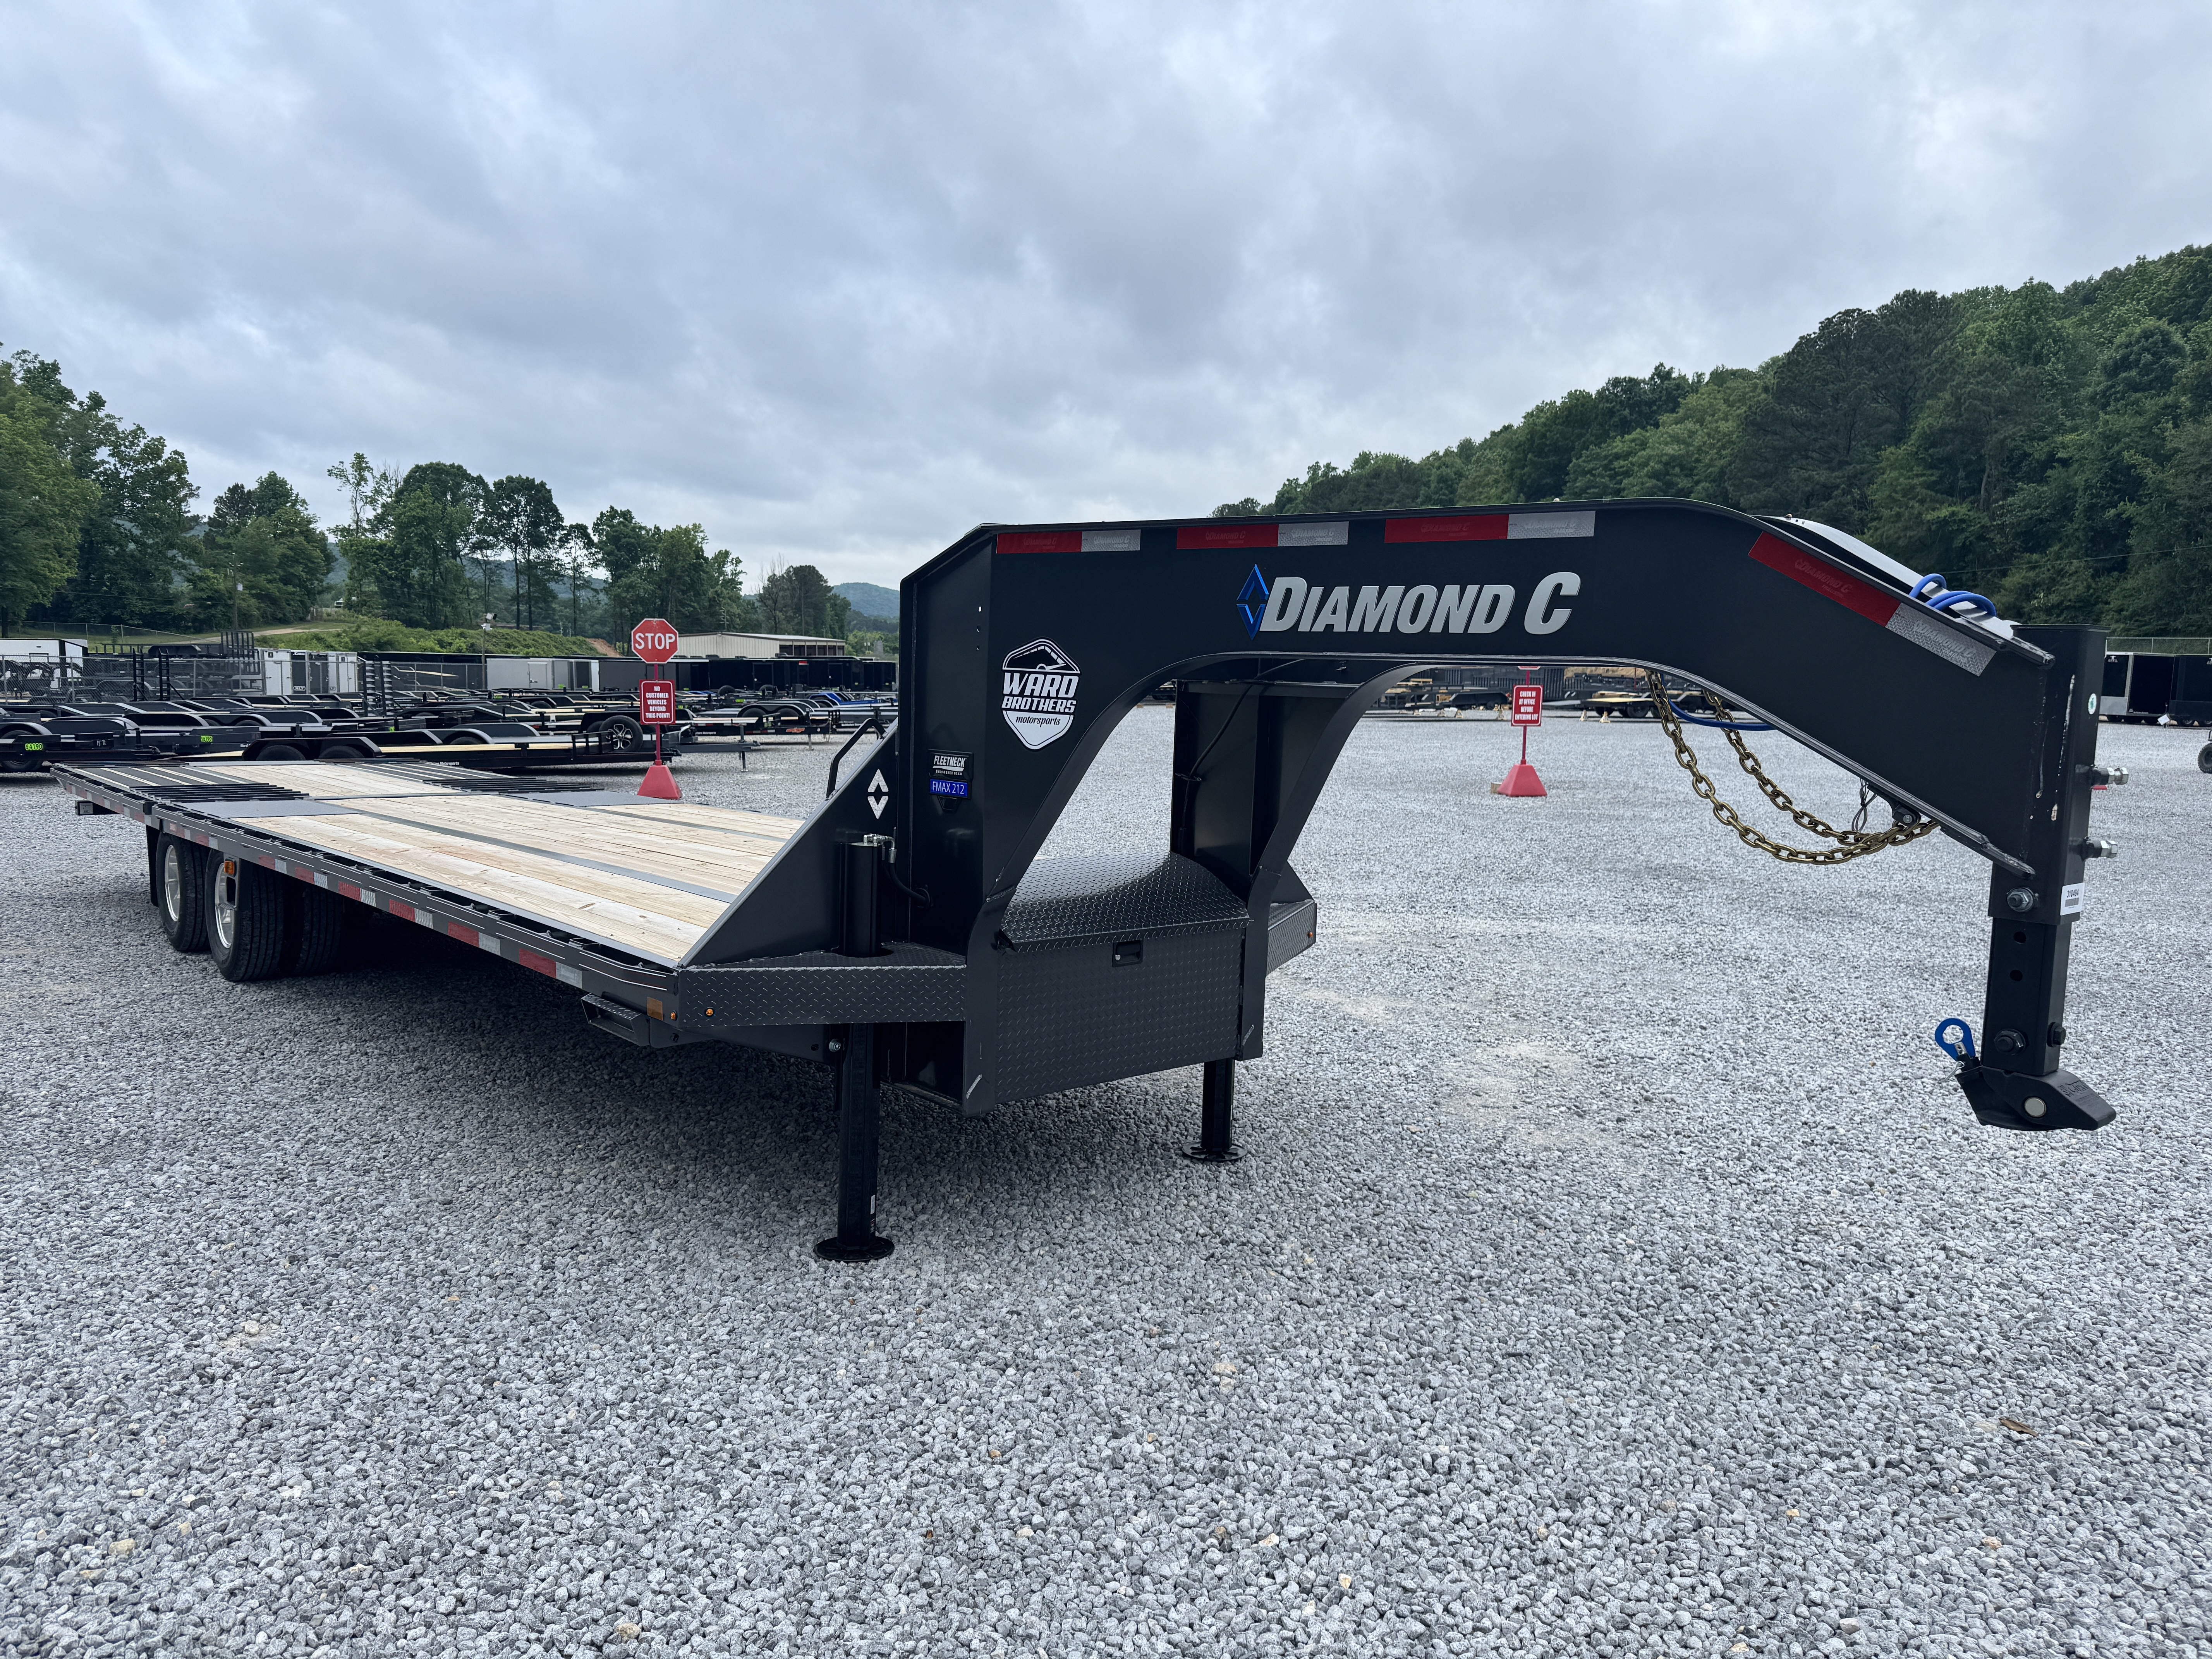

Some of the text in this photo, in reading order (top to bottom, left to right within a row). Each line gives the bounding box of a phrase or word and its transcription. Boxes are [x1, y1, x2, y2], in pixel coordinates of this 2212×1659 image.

[1209, 531, 1246, 540] DIAMOND C
[1801, 562, 1853, 592] DIAMOND C
[1260, 572, 1581, 635] DIAMOND C
[635, 633, 675, 649] STOP
[1003, 672, 1079, 698] WARD
[1001, 696, 1077, 713] BROTHERS
[1015, 716, 1061, 727] motorsports
[934, 756, 965, 767] FLEETNECK
[933, 781, 964, 794] FMAX 212
